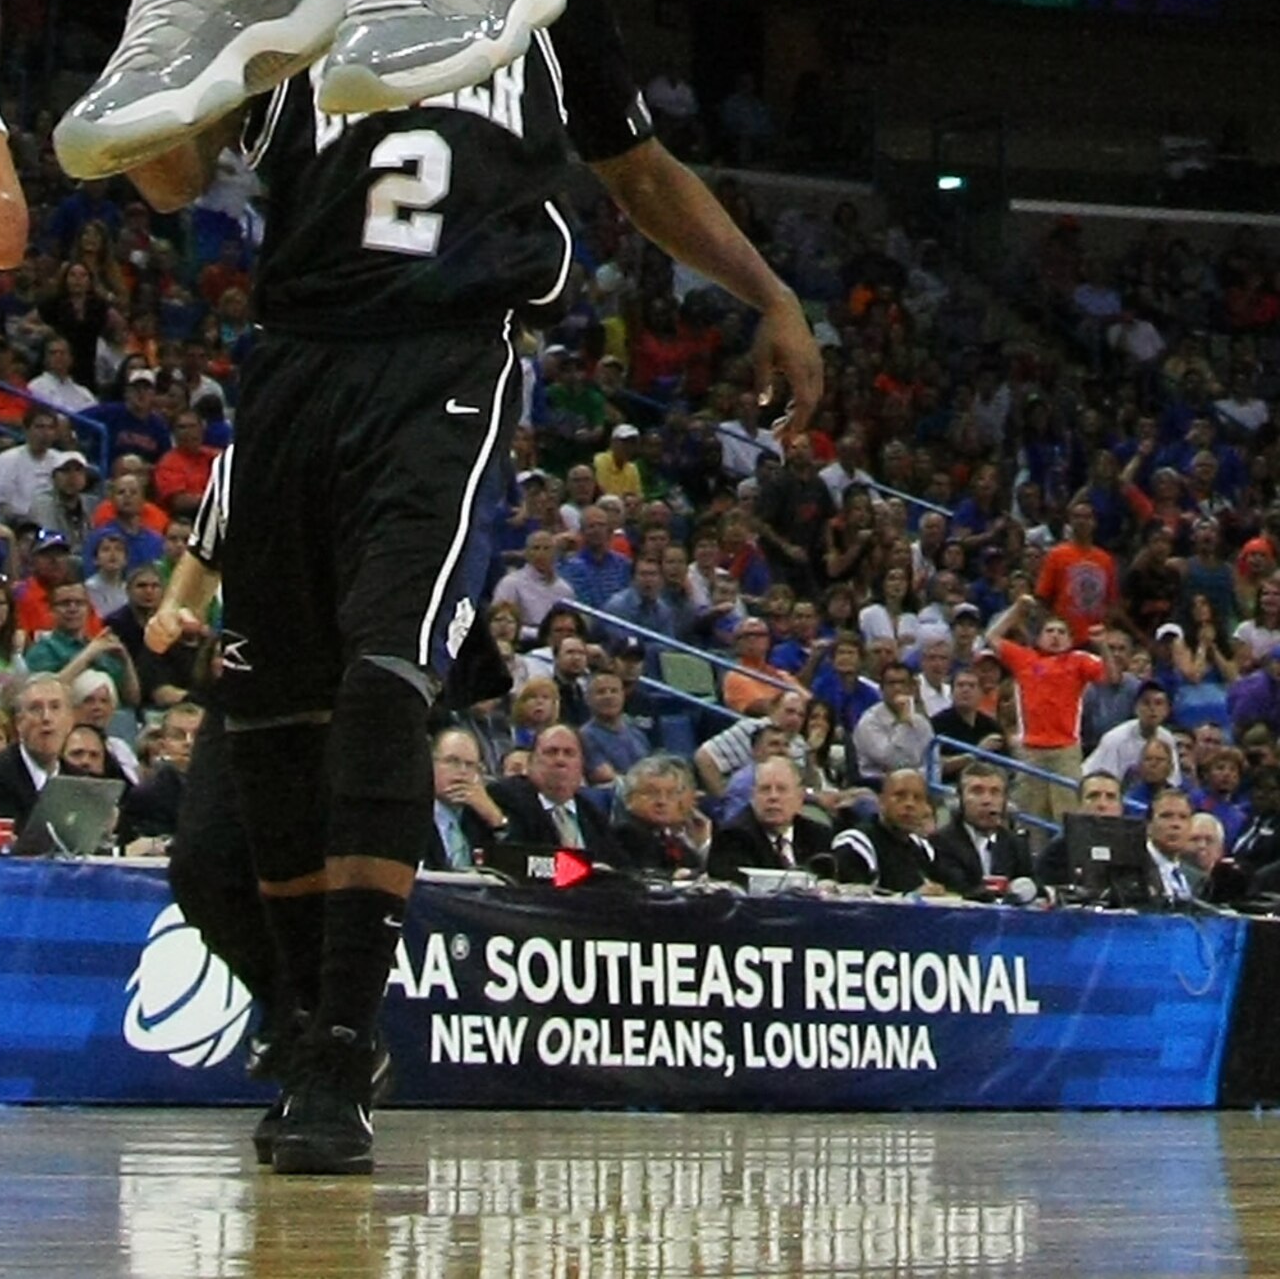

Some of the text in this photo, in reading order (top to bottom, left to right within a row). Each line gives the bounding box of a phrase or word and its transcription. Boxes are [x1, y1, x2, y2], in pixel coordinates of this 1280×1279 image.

[360, 128, 454, 258] 2
[484, 934, 794, 1009] SOUTHEAST
[804, 947, 1040, 1016] REGIONAL
[430, 1013, 938, 1078] NEW ORLEANS, LOUISIANA
